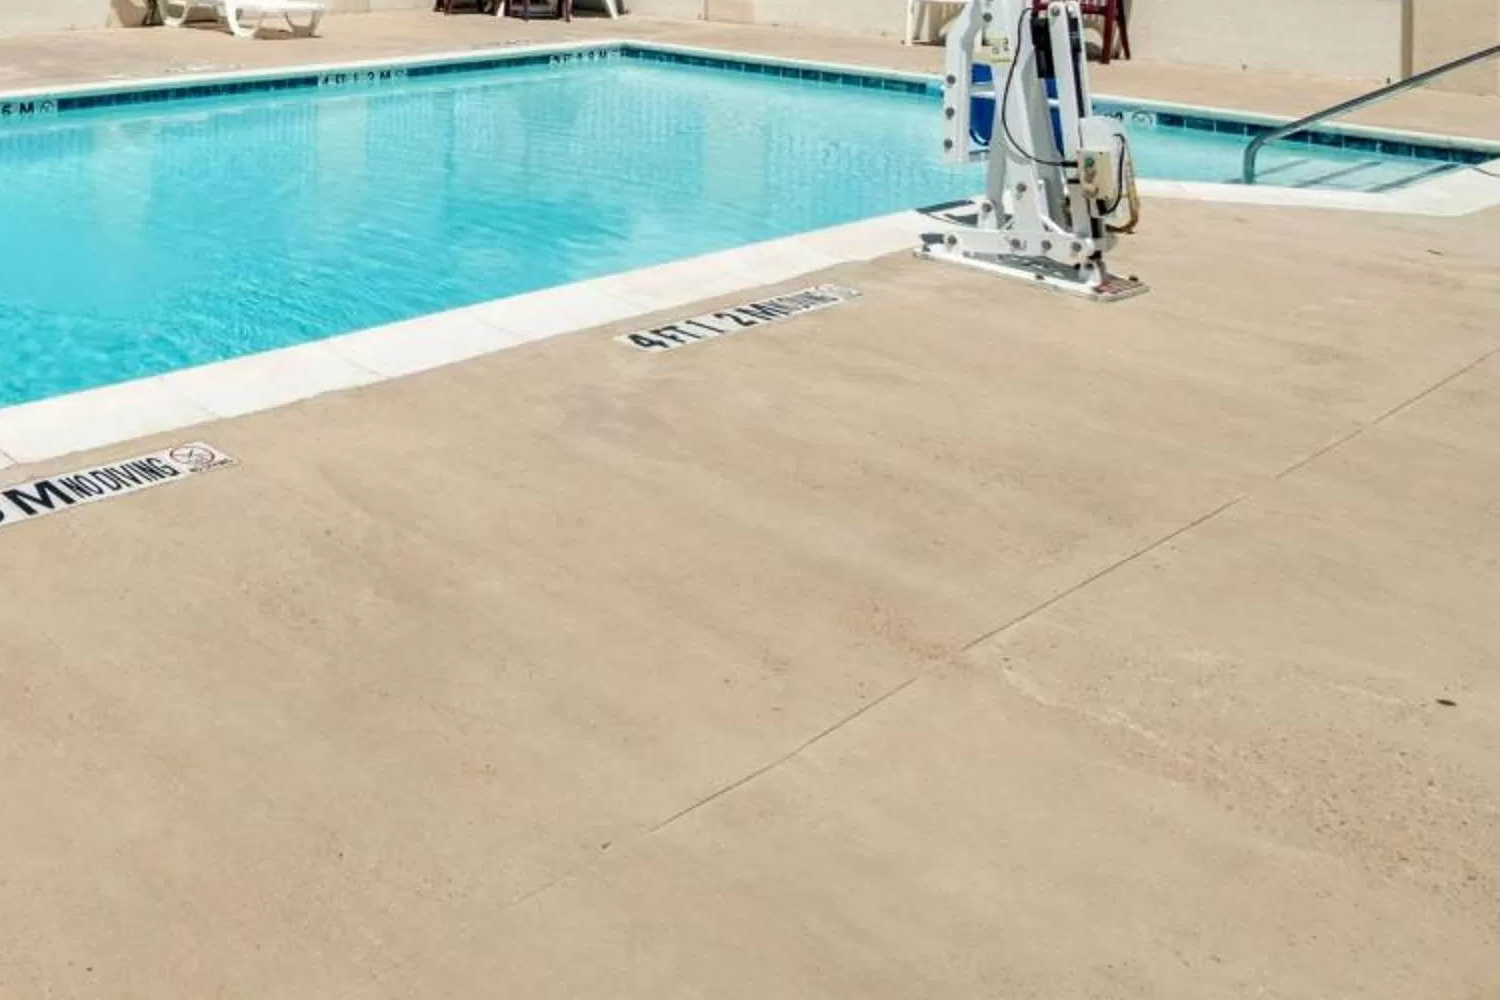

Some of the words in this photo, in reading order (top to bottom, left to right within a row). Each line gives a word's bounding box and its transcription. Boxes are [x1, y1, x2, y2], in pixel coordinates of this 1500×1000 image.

[2, 480, 76, 516] M
[57, 472, 103, 499] NO
[88, 457, 181, 491] DIVING
